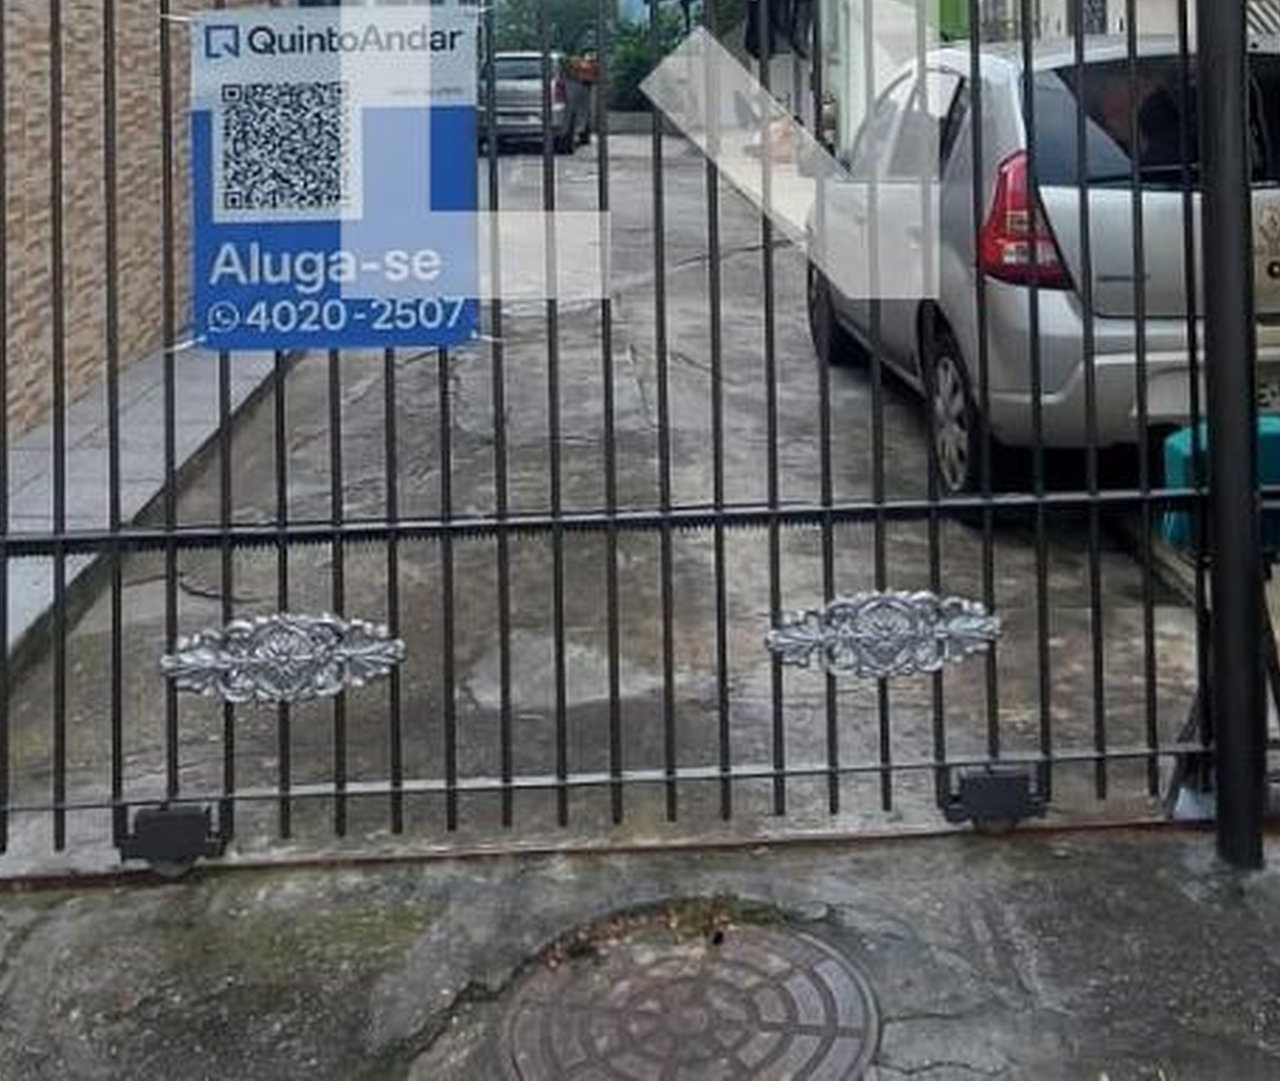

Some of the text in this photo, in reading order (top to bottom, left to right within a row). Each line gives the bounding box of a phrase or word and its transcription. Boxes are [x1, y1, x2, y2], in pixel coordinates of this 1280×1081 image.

[247, 25, 464, 56] QuintoAndar
[208, 241, 442, 294] Aluga-se
[245, 296, 465, 333] 4020-2507
